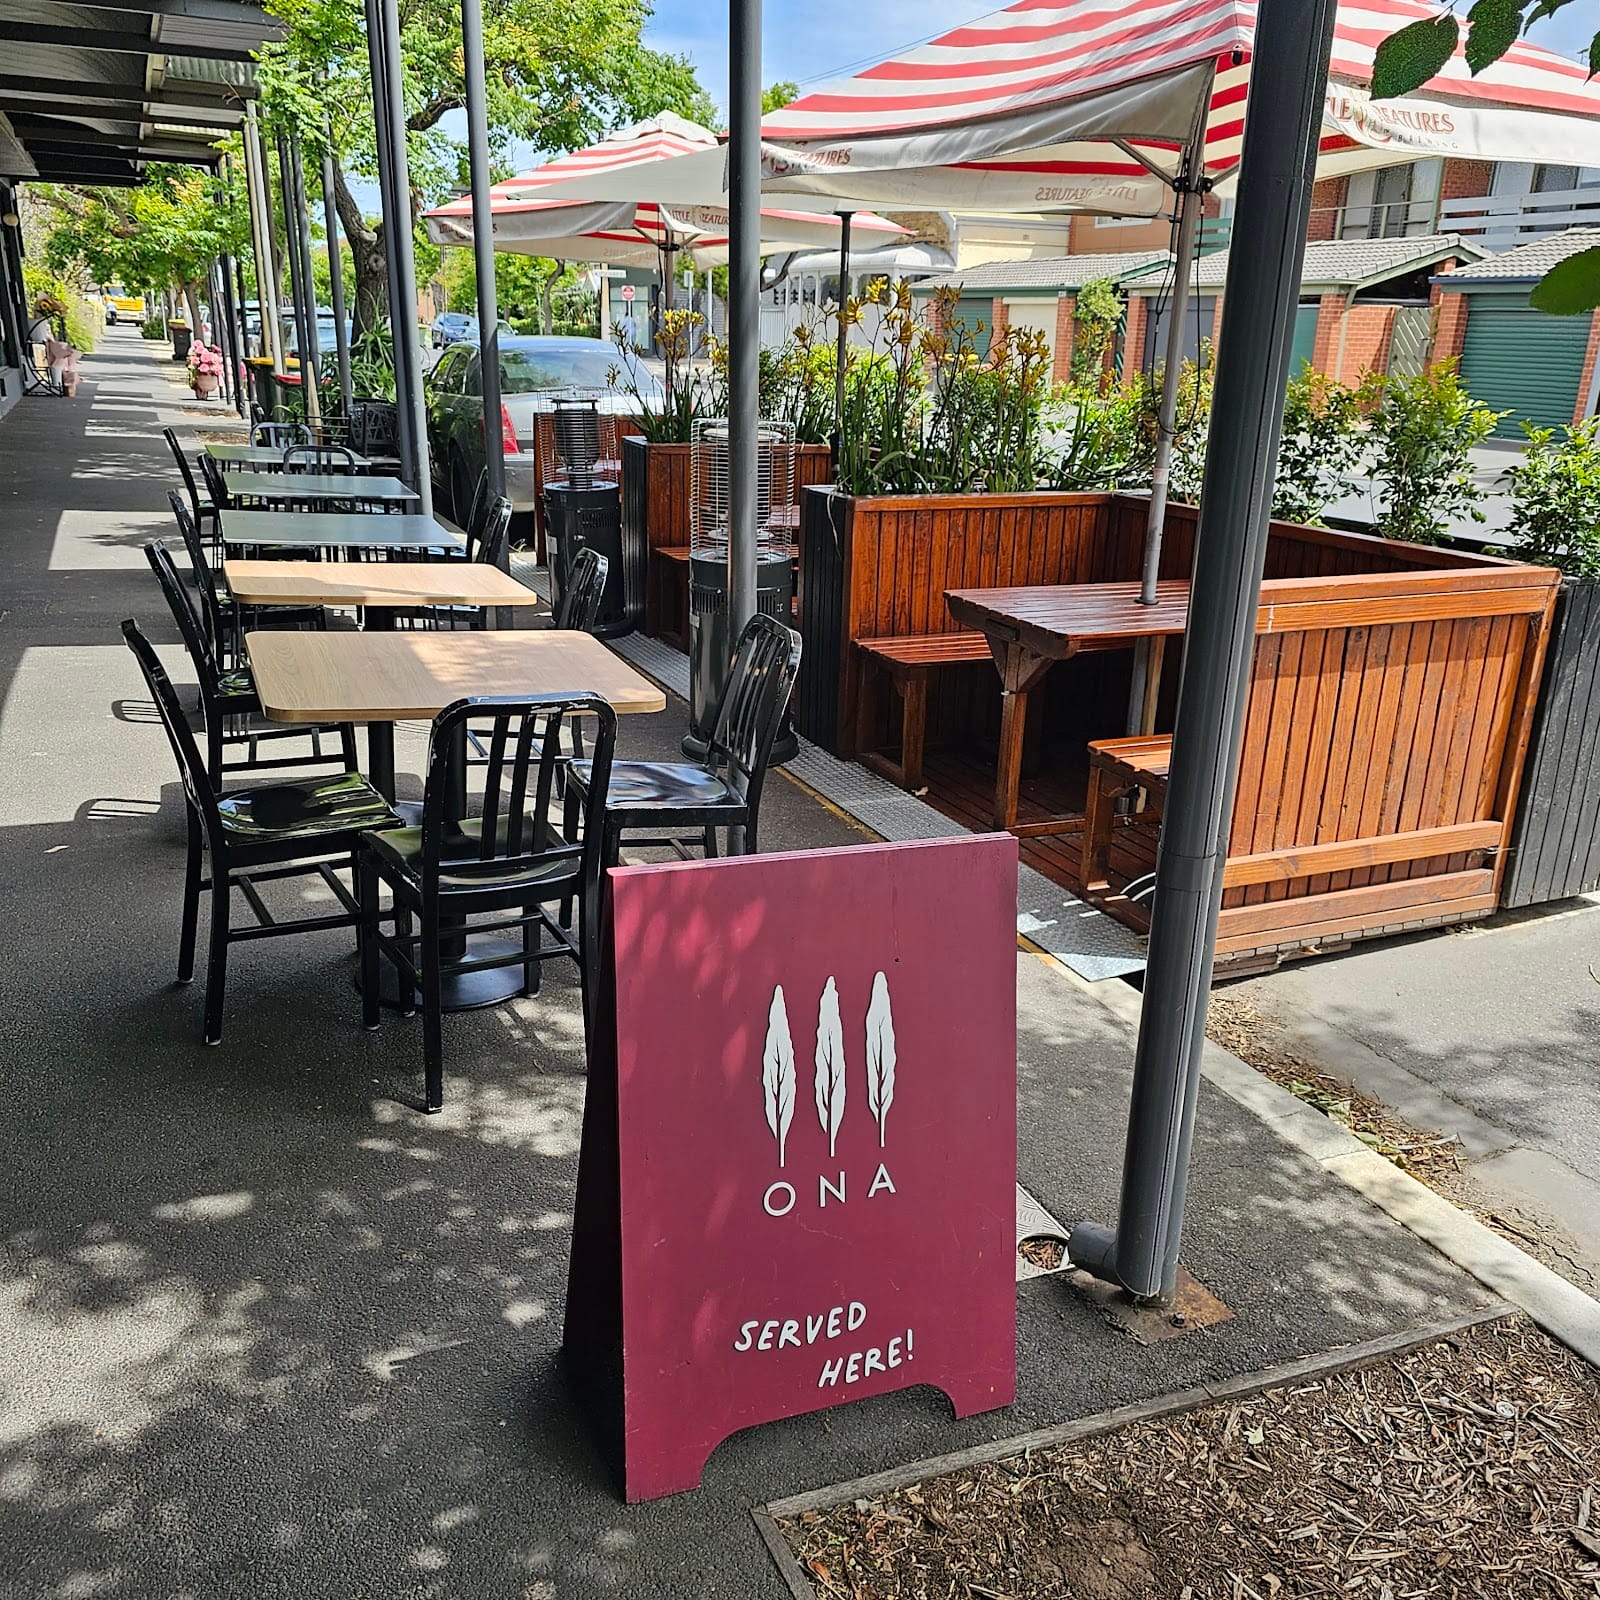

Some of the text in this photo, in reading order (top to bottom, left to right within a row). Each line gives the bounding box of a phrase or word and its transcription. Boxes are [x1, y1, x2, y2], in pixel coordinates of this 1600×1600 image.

[763, 1163, 897, 1217] ONA
[734, 1302, 867, 1351] SERVED
[818, 1328, 914, 1388] HERE!
